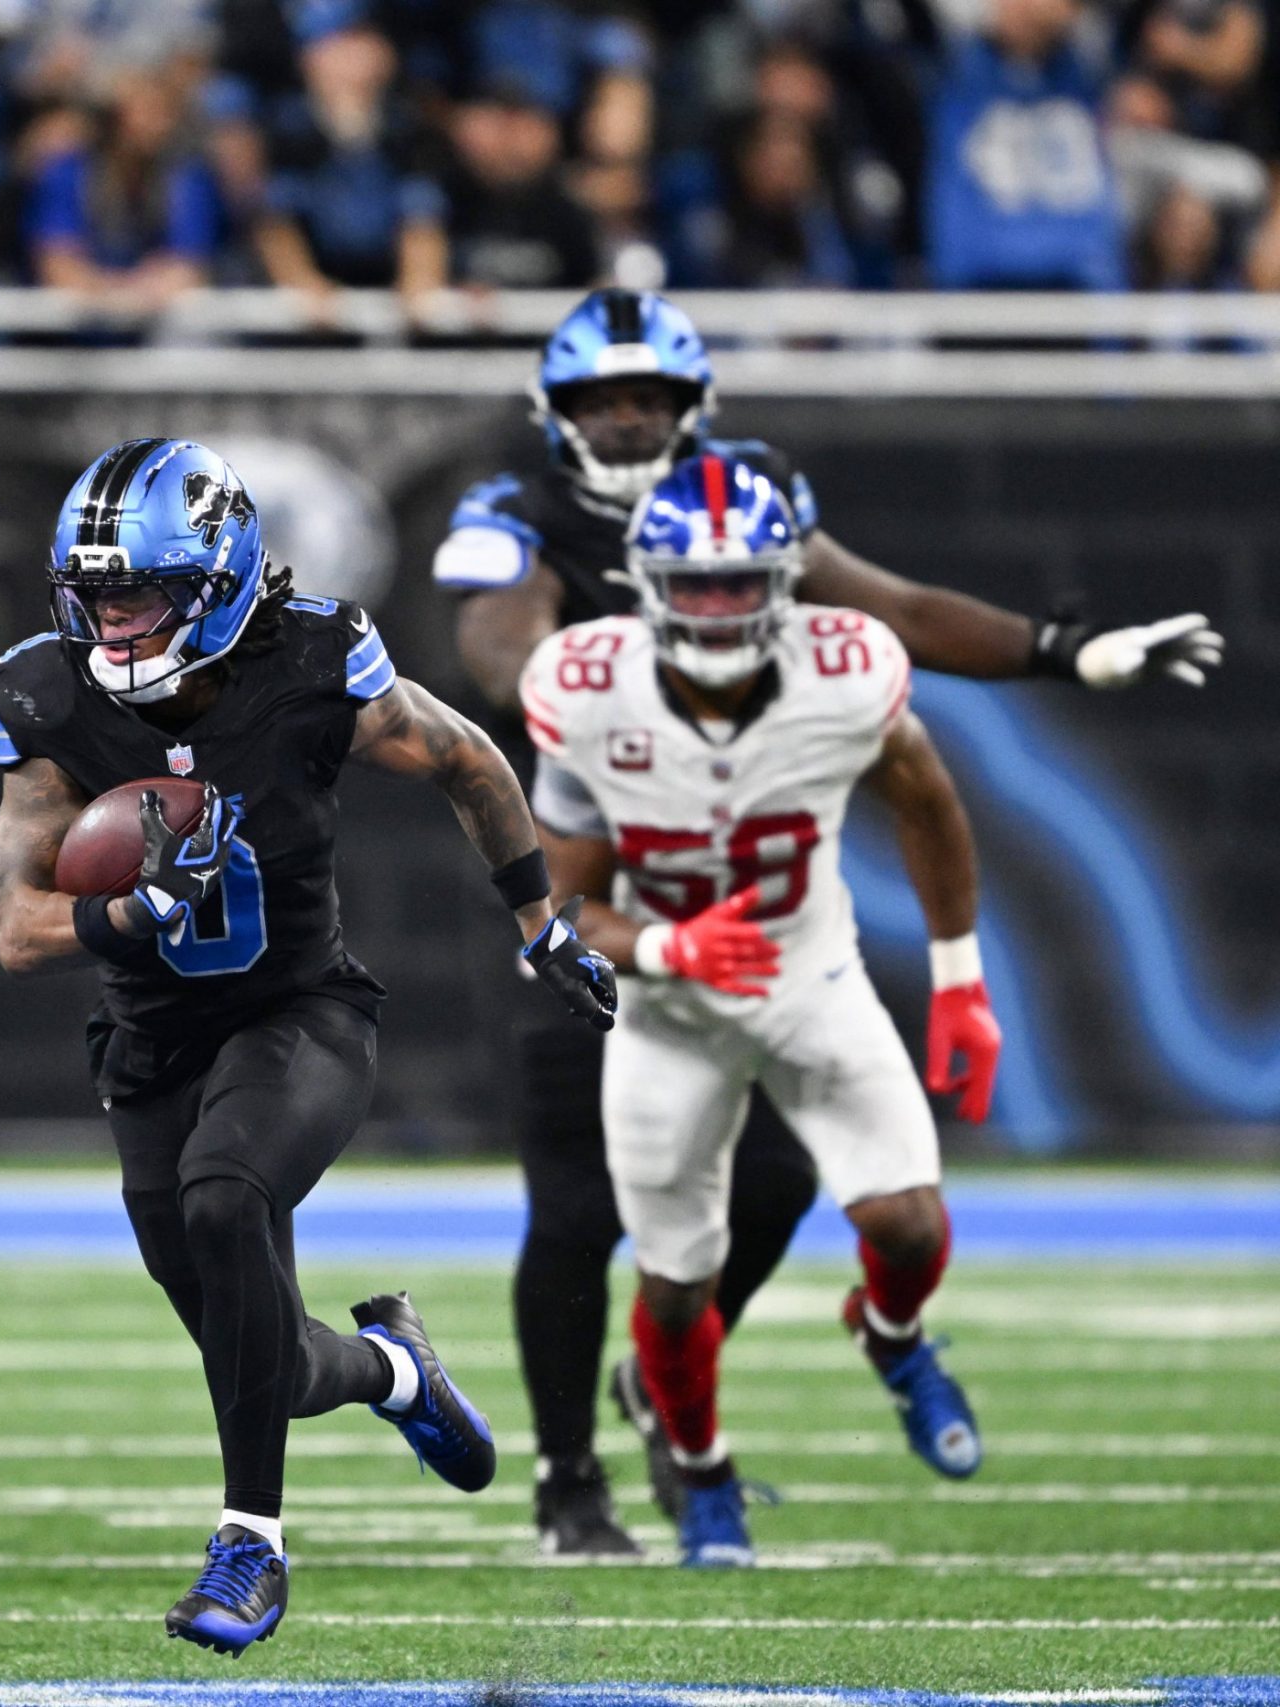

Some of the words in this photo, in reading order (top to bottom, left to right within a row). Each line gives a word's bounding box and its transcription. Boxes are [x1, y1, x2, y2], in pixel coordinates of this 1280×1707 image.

[557, 627, 624, 692] 58
[808, 613, 872, 678] 58
[616, 810, 823, 926] 58
